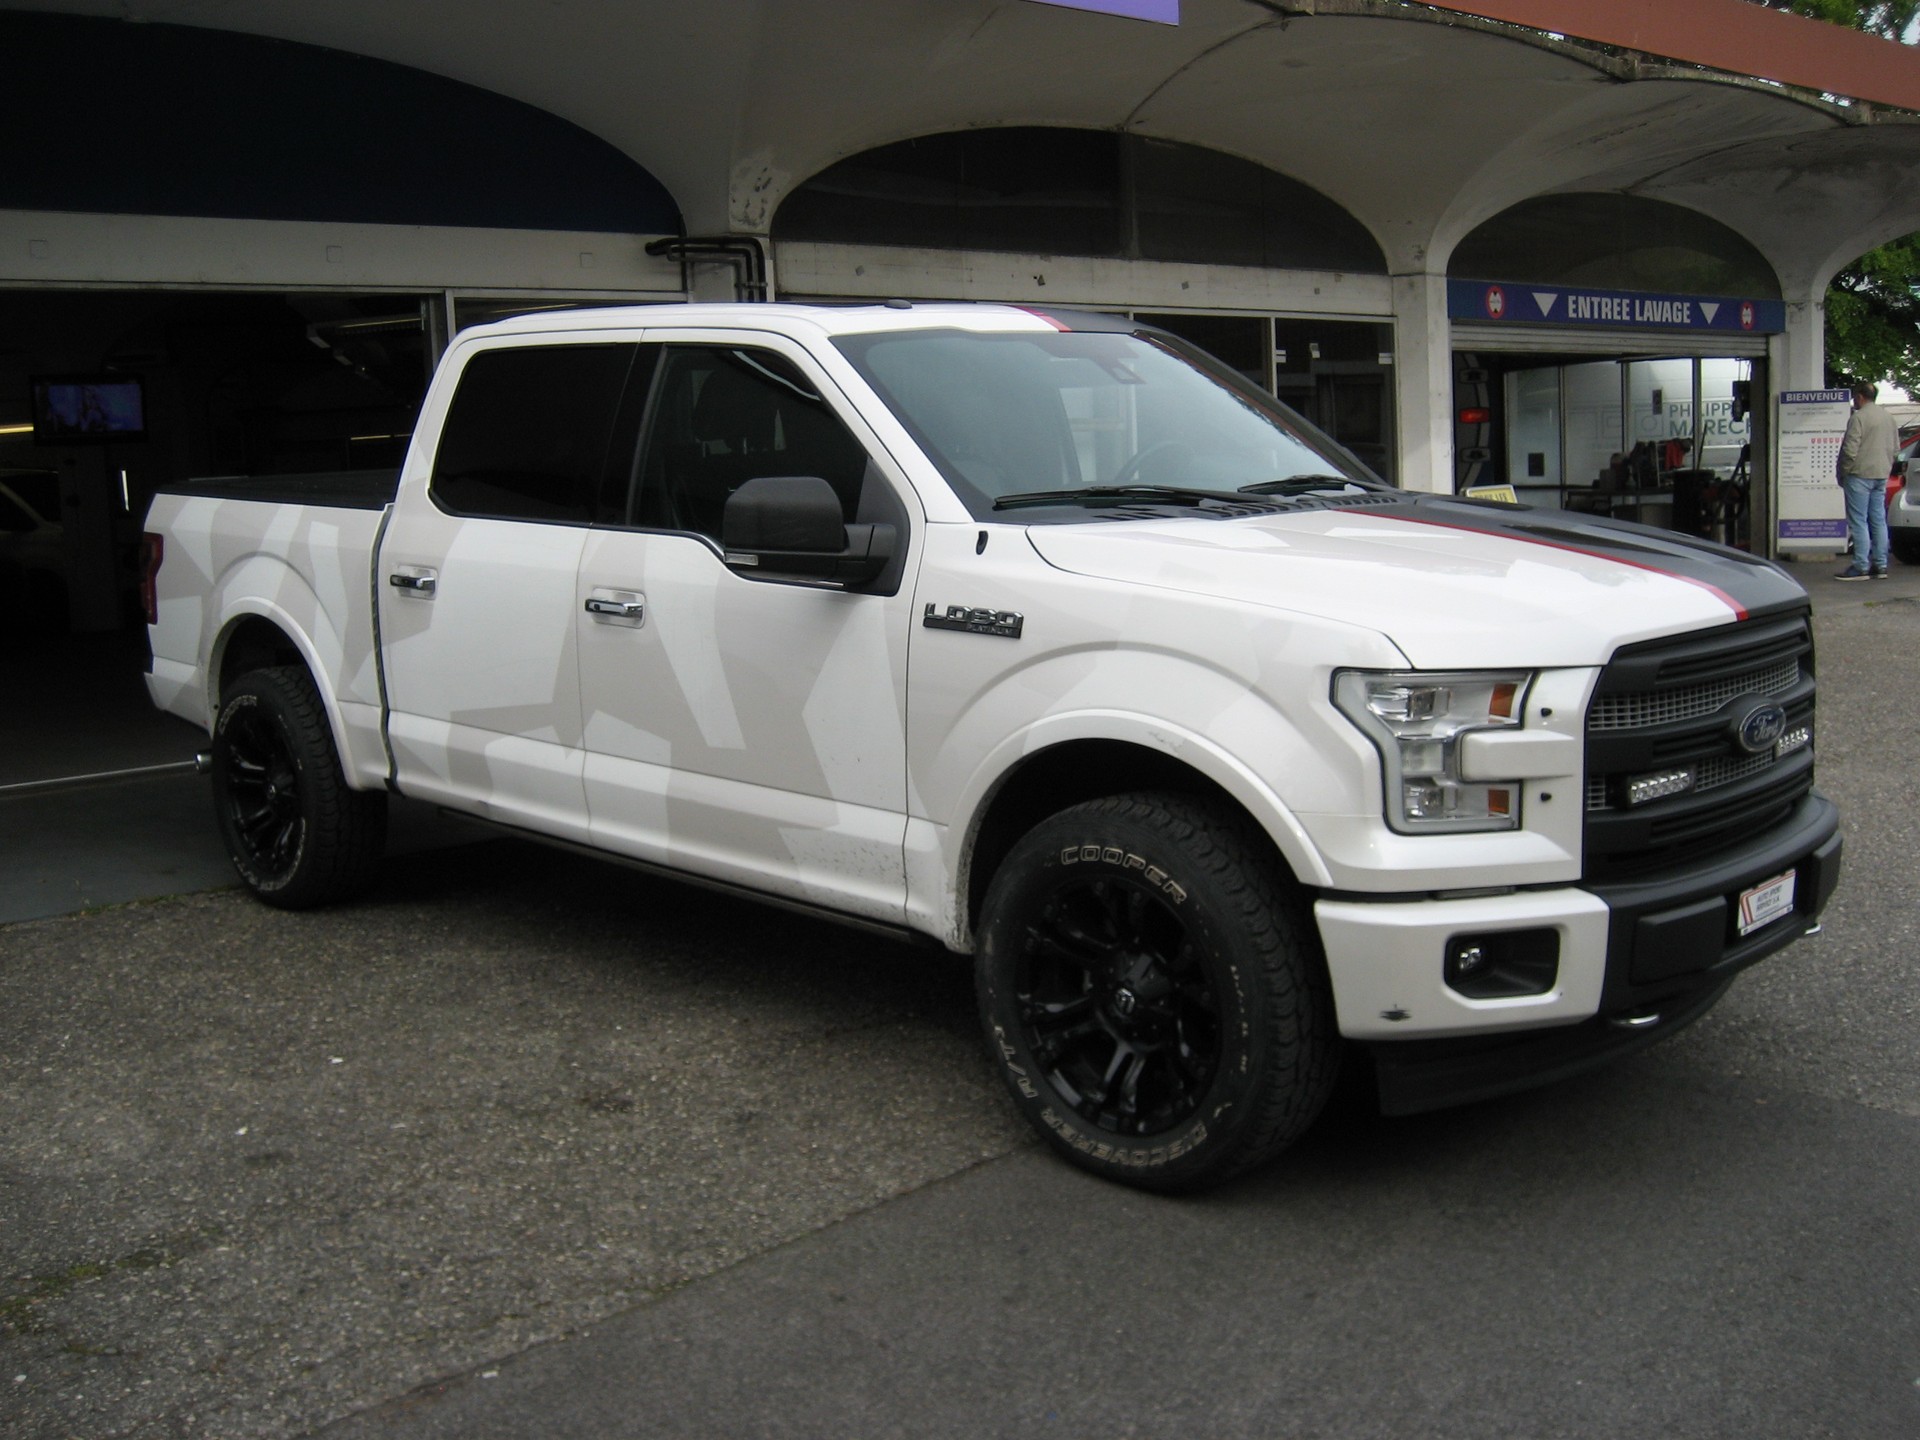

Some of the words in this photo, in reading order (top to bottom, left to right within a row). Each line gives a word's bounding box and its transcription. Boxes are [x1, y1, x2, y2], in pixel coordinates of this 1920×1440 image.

[1567, 295, 1631, 321] ENTREE
[1635, 299, 1692, 324] LAVAGE
[1786, 392, 1844, 401] BIENVENUE
[1669, 402, 1733, 418] PHIPP
[1669, 419, 1752, 437] MREC
[1753, 713, 1780, 743] Ford
[1060, 845, 1188, 904] COOPER
